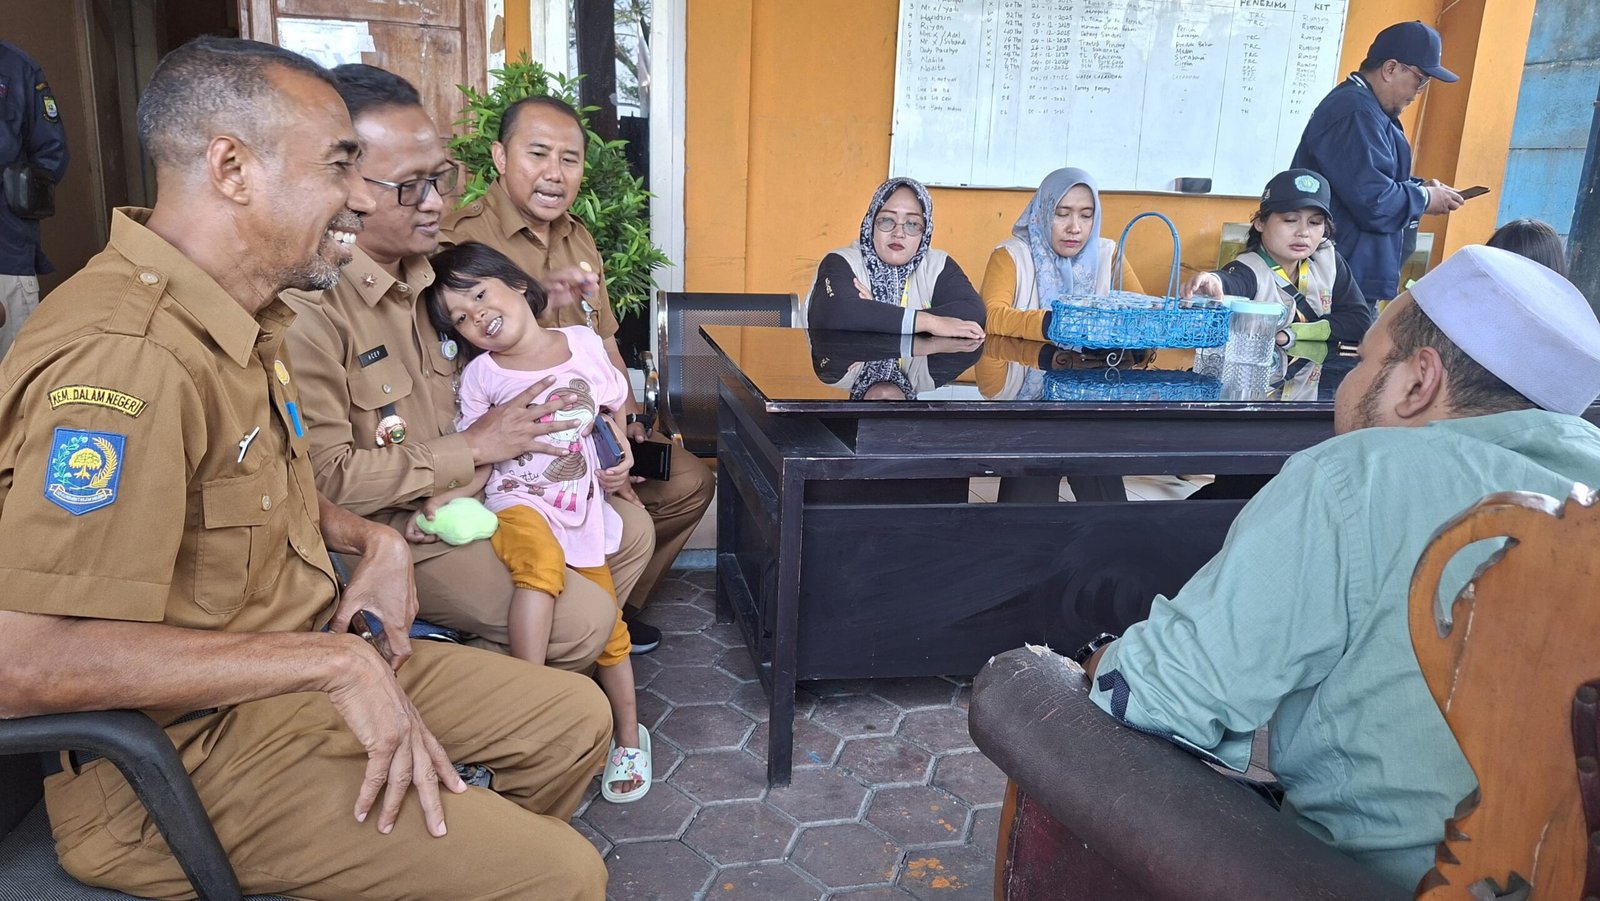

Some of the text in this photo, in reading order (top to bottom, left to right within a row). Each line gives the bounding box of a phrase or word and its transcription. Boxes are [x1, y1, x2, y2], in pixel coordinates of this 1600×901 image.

[1240, 0, 1287, 9] PENERIMA
[1314, 3, 1331, 11] KET
[73, 389, 105, 403] DALAM
[105, 392, 142, 413] NEGERI
